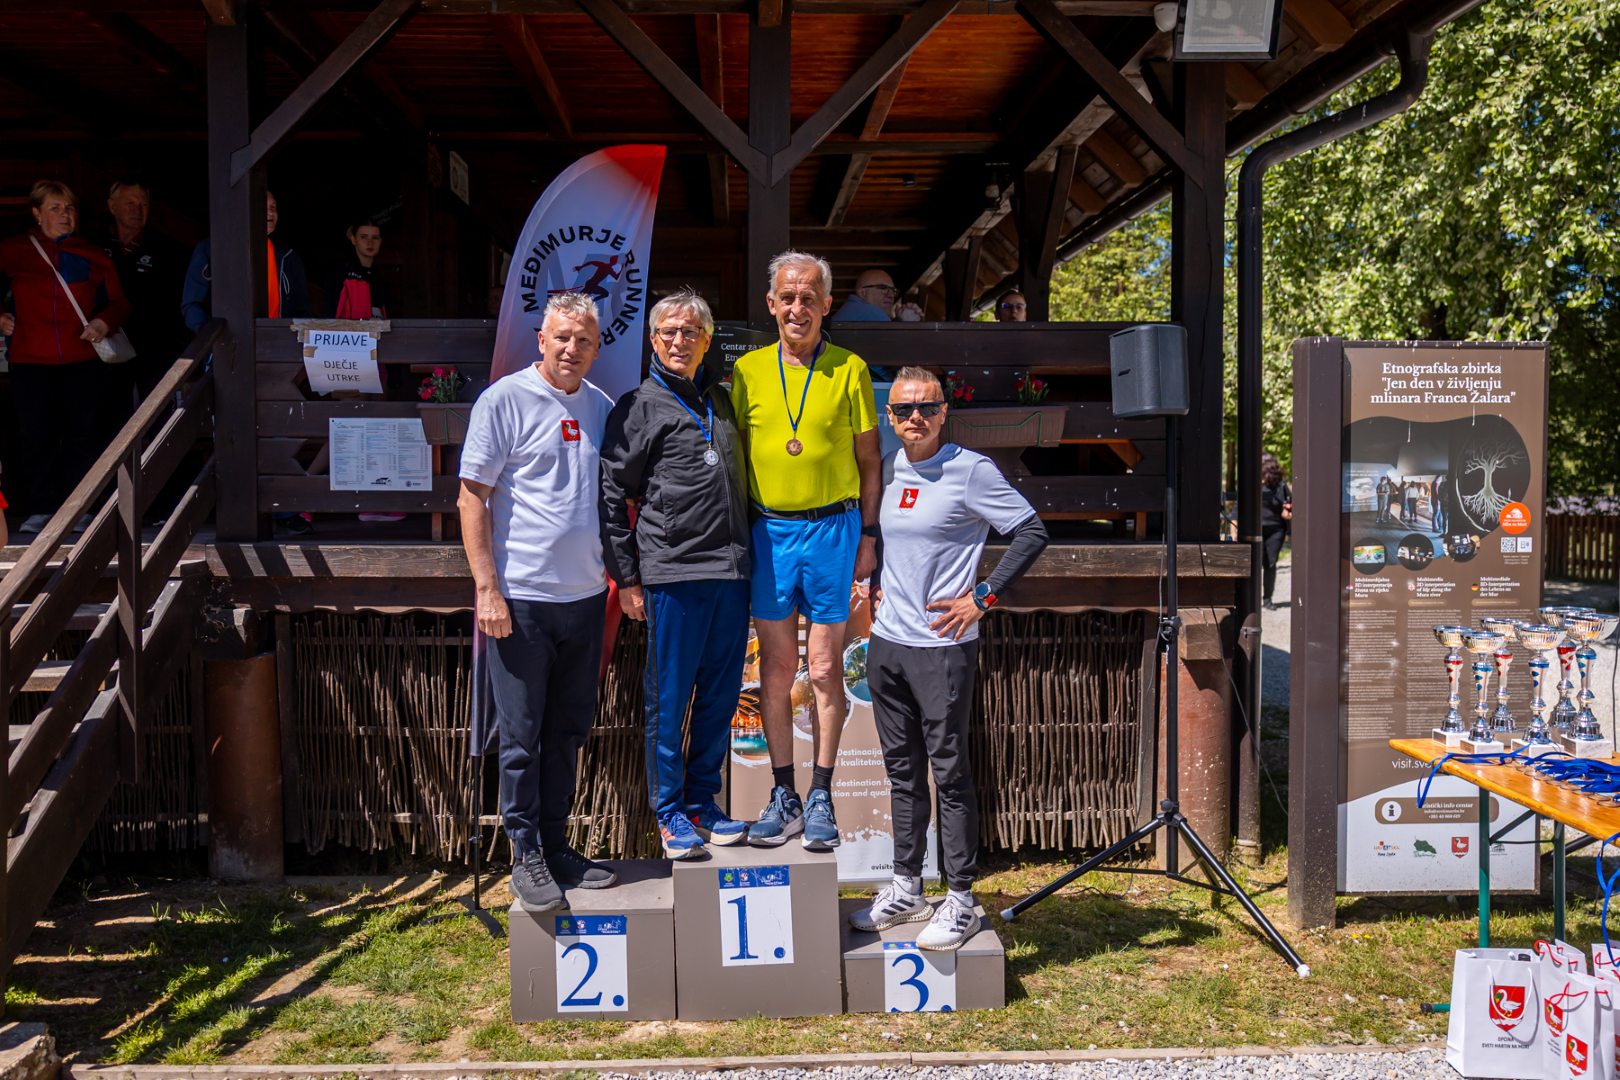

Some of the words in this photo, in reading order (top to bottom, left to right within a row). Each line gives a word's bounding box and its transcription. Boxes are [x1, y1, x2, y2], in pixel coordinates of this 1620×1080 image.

[521, 225, 626, 313] MEĐIMURJE
[601, 249, 643, 346] RUNNER
[314, 333, 368, 347] PRIJAVE
[720, 342, 746, 351] Centar
[747, 343, 757, 351] za
[323, 359, 359, 371] DJEČJE
[1382, 362, 1459, 377] Etnografska
[1461, 362, 1502, 375] zbirka
[327, 374, 361, 383] UTRKE
[1381, 377, 1407, 391] "Jen
[1410, 377, 1434, 389] den
[1436, 380, 1445, 389] v
[1447, 376, 1502, 391] življenju
[1370, 391, 1421, 404] mlinara
[1424, 391, 1468, 404] Franca
[1470, 389, 1516, 404] Žalara"
[837, 747, 883, 758] Destinacija
[836, 778, 882, 788] destination
[852, 788, 868, 797] and
